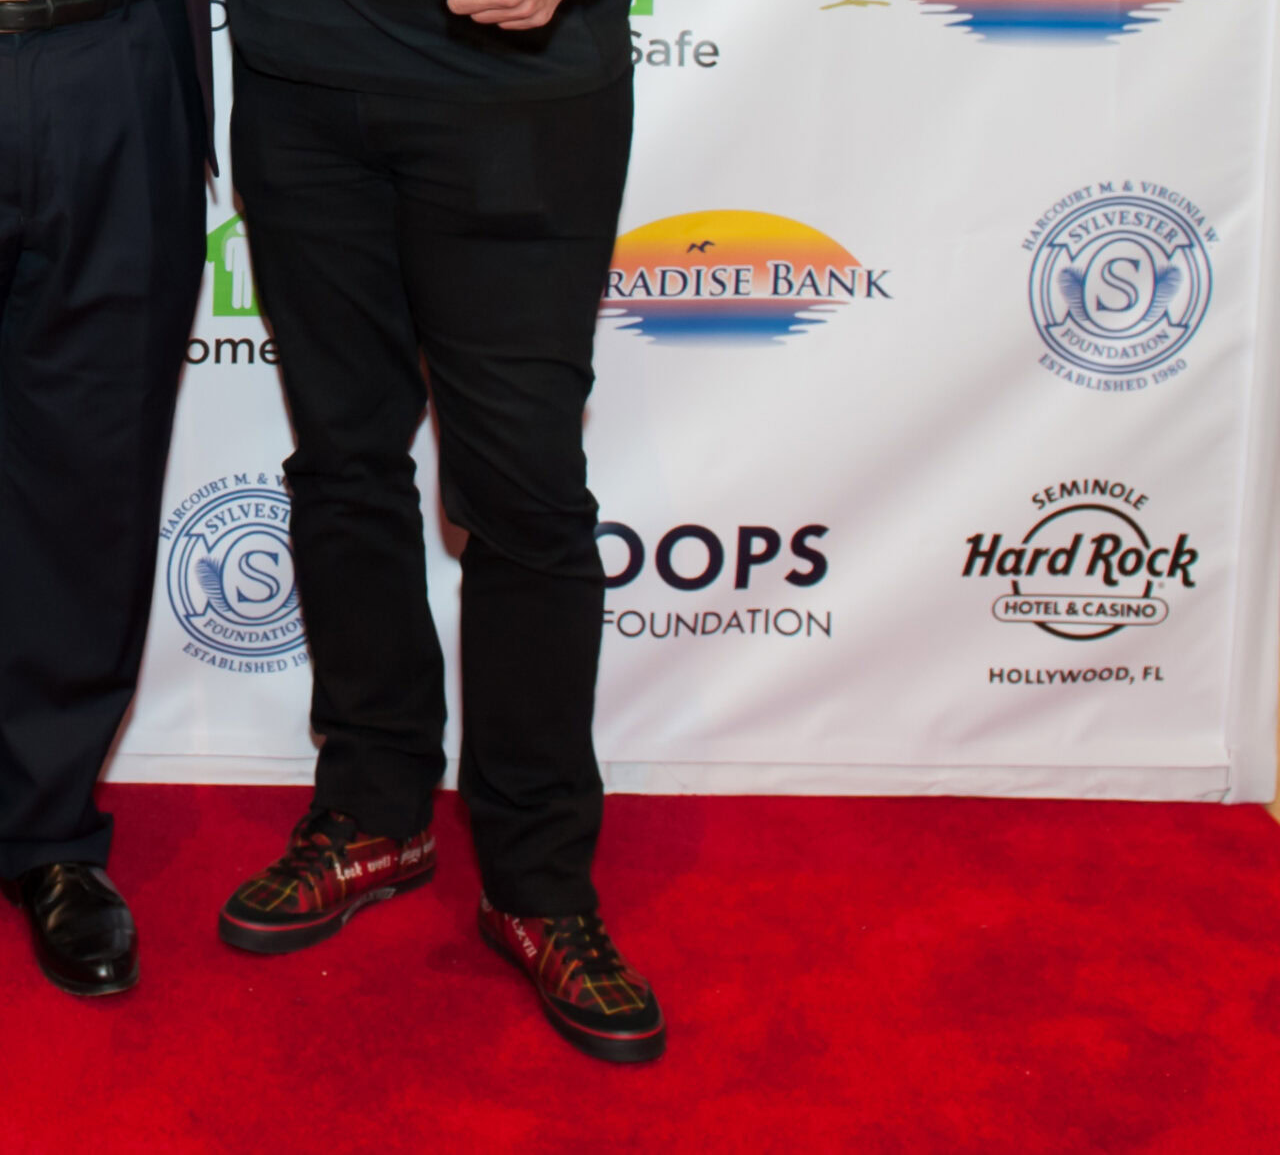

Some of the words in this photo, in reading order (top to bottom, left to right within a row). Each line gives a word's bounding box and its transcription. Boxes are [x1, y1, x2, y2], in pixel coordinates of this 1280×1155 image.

[1022, 186, 1093, 251] HARCOURT
[1122, 180, 1133, 192] &
[1140, 181, 1207, 228] VIRGINIA
[1068, 210, 1178, 245] SYLVESTER
[605, 266, 752, 298] RADISE
[770, 262, 894, 299] BANK
[1061, 328, 1170, 359] FOUNDATION
[1038, 353, 1148, 391] ESTABLISHED
[1153, 358, 1187, 385] 1980
[159, 477, 228, 540] HARCOURT
[257, 473, 268, 485] &
[1031, 479, 1149, 510] SEMINOLE
[205, 503, 290, 535] SYLVEST
[594, 521, 829, 591] OOPS
[962, 533, 1083, 577] Hard
[1086, 533, 1198, 588] Rock
[1004, 601, 1060, 615] HOTEL
[1066, 602, 1078, 616] &
[1082, 603, 1157, 618] CASINO
[182, 642, 287, 673] ESTABLISHED
[292, 652, 308, 667] 19
[989, 667, 1135, 684] HOLLYWOOD,
[1143, 666, 1164, 681] FL
